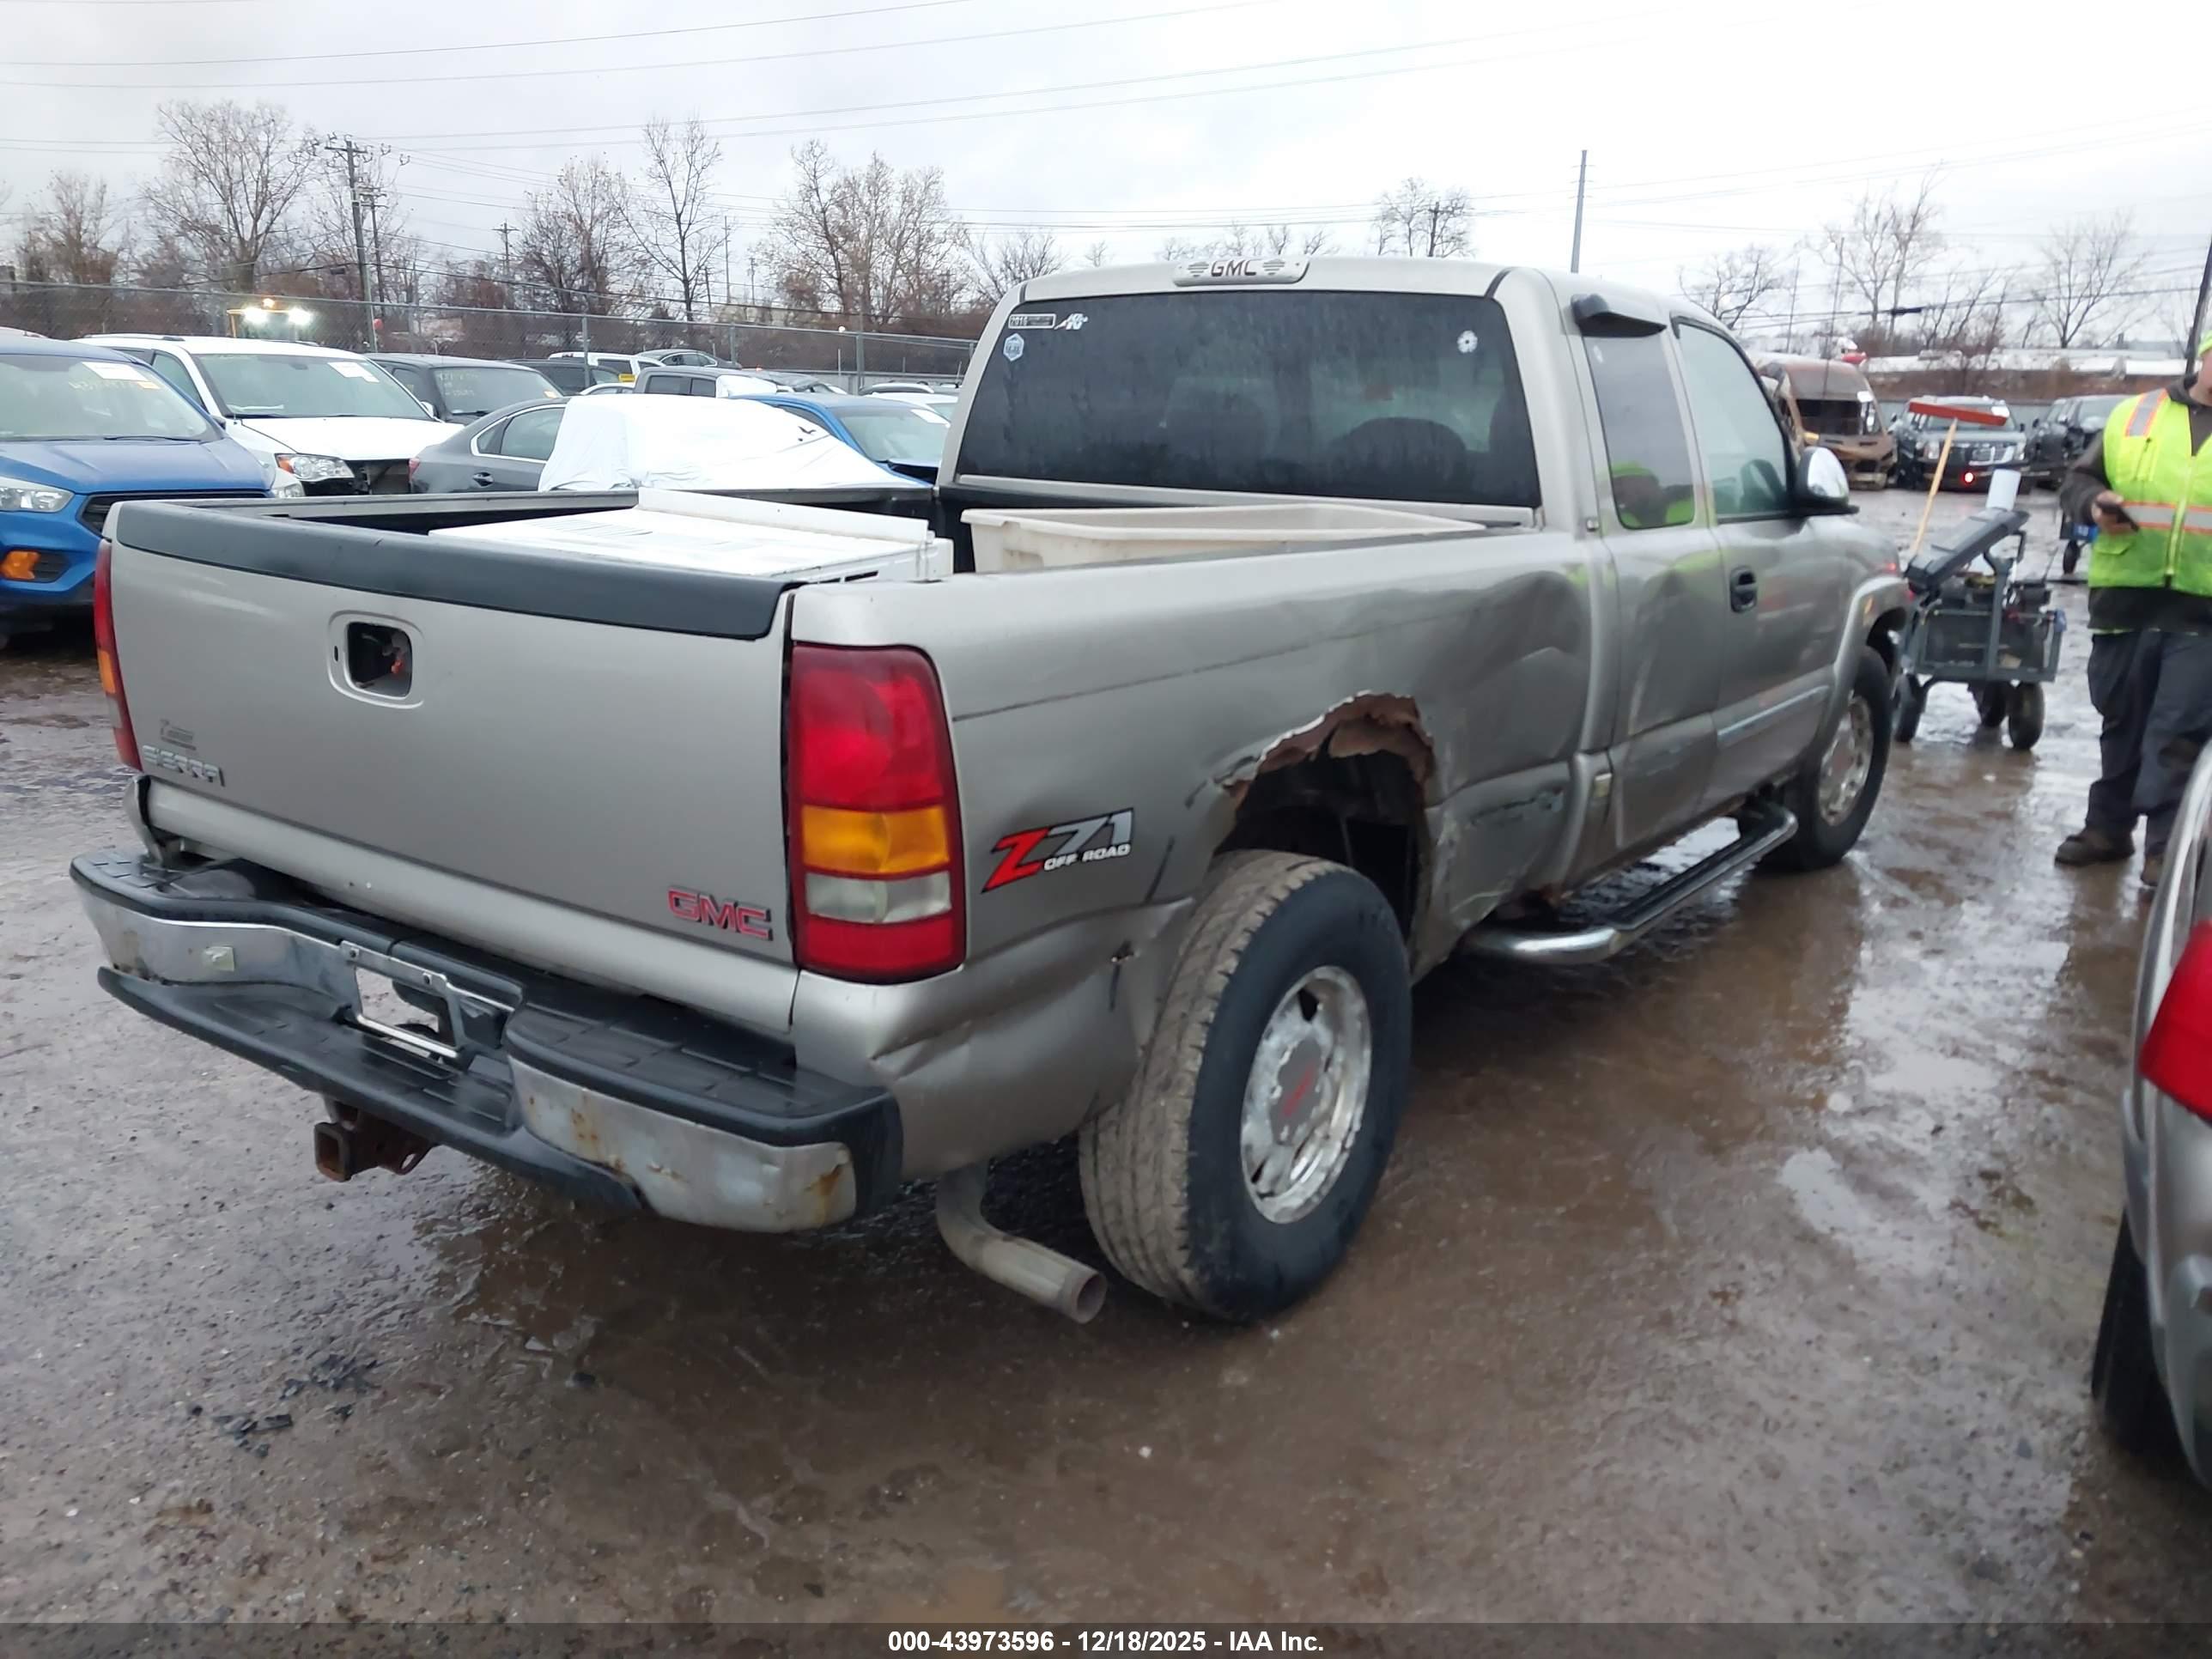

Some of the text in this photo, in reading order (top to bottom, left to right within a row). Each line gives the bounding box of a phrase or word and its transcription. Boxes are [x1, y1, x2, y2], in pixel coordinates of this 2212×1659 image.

[1211, 258, 1264, 276] GMC
[142, 744, 225, 787] SIERRA
[981, 807, 1133, 894] Z71
[1043, 843, 1132, 872] OFF ROAD
[667, 886, 774, 941] GMC
